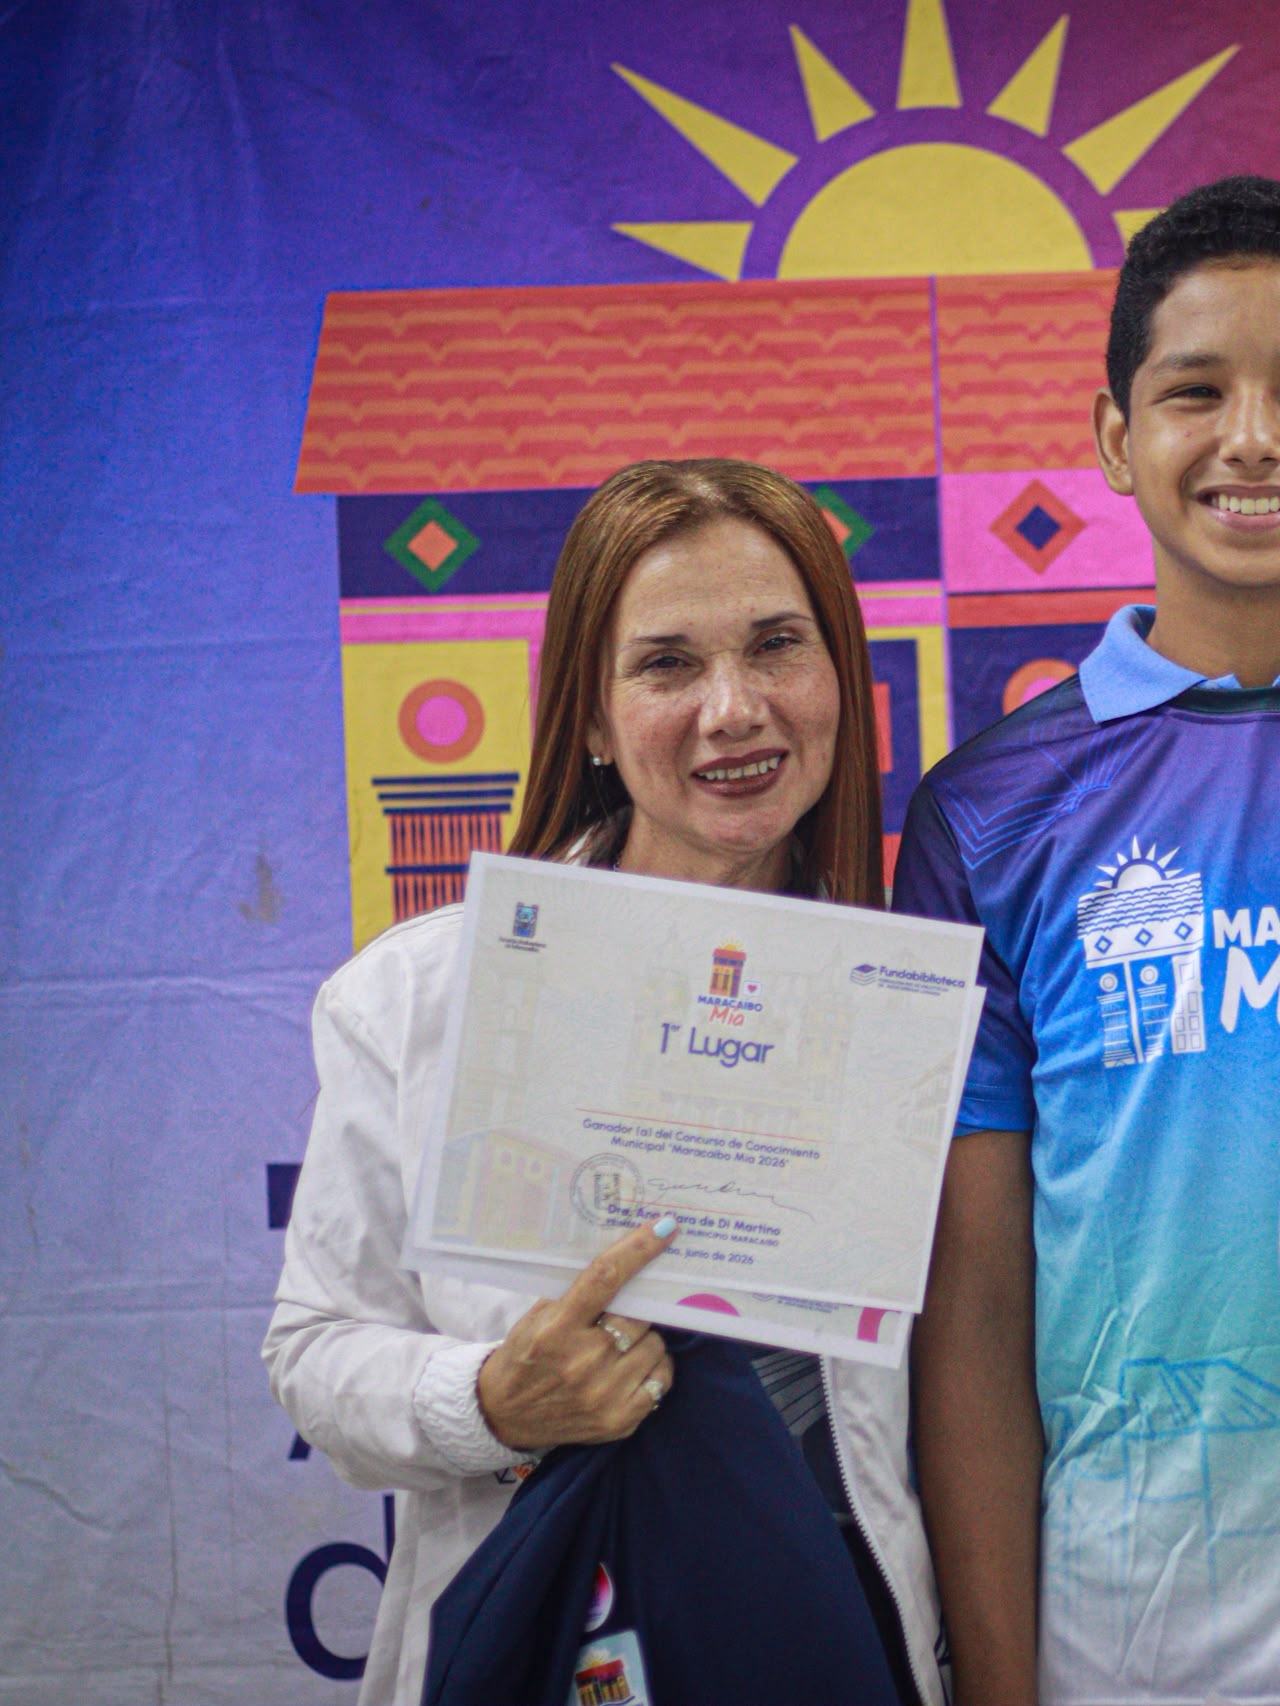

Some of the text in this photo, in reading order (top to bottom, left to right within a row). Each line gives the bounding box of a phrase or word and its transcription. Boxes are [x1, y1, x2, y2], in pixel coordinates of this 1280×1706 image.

[879, 965, 966, 988] Fundabiblioteca
[698, 995, 763, 1012] MARACAIBO
[709, 1004, 745, 1026] Mía
[688, 1027, 775, 1068] Lugar
[582, 1118, 632, 1135] Ganador
[655, 1128, 672, 1140] del
[675, 1131, 726, 1147] Concurso
[728, 1138, 743, 1149] de
[745, 1140, 821, 1160] Conocimiento
[610, 1136, 665, 1153] Municipal
[699, 1216, 715, 1227] de
[734, 1221, 781, 1236] Martino
[684, 1247, 710, 1260] junio
[712, 1250, 725, 1262] de
[728, 1253, 754, 1265] 2026
